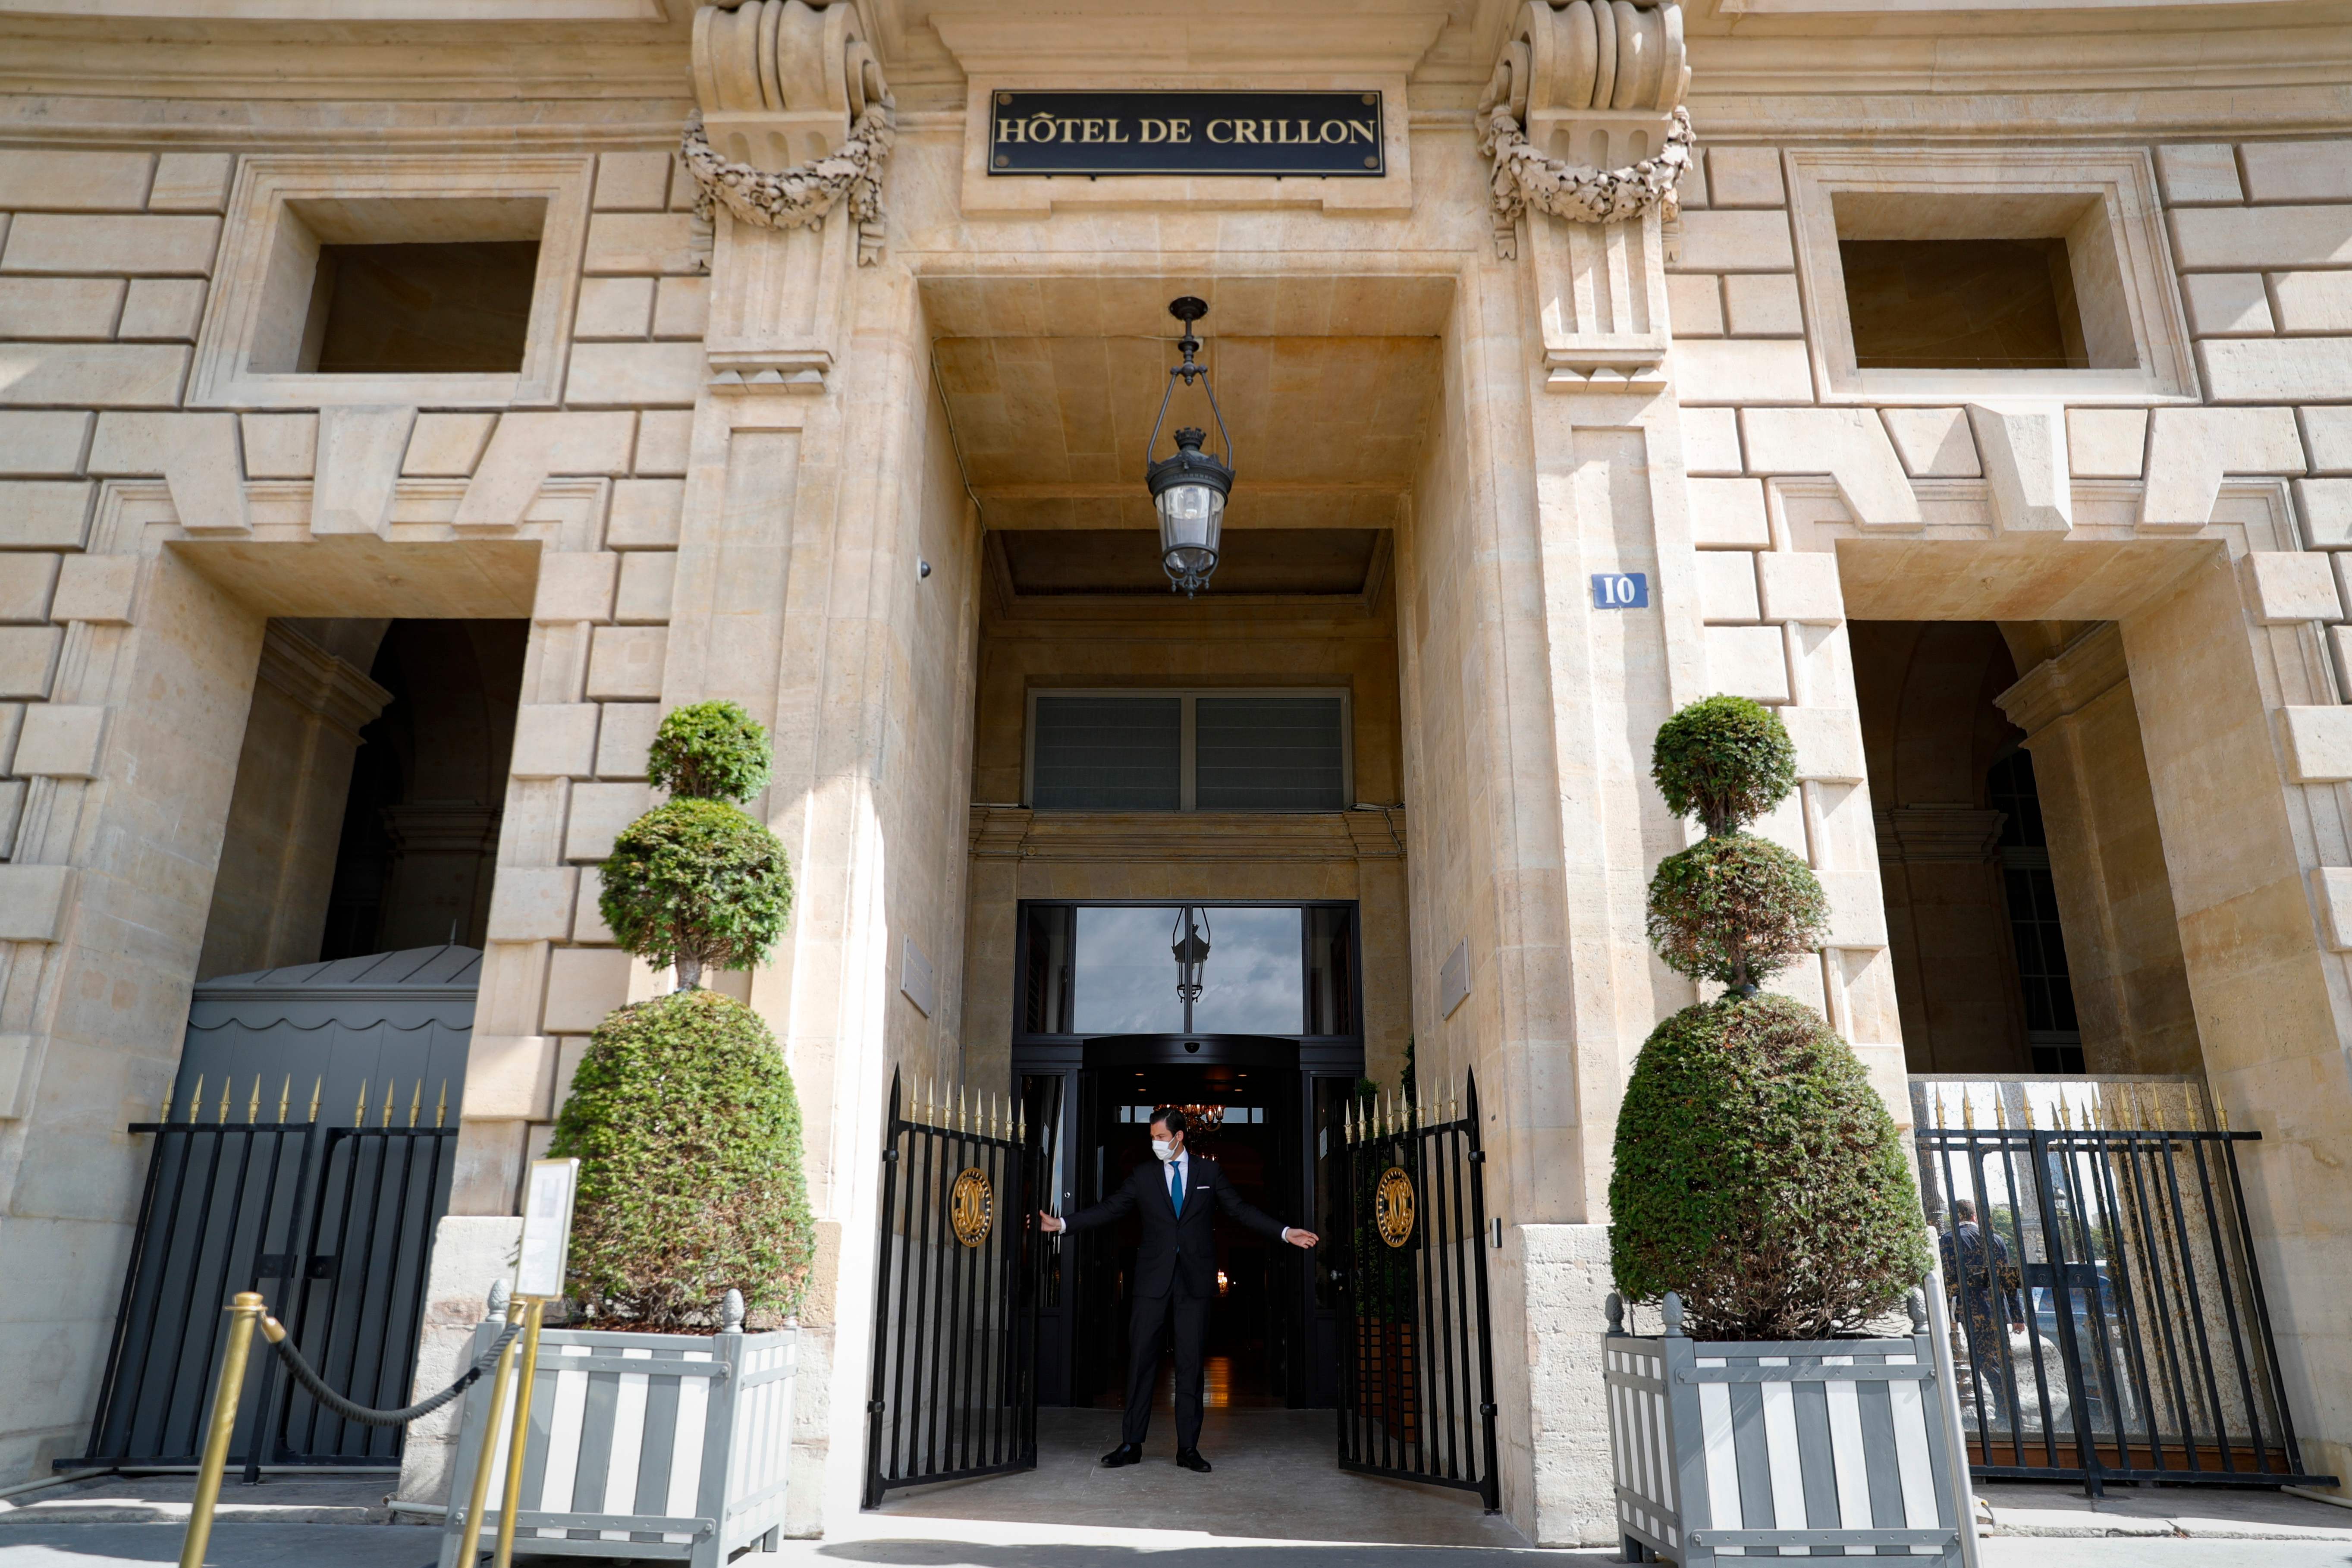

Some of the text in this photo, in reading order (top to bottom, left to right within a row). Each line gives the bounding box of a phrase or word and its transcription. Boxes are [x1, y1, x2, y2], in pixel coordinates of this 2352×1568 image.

[996, 111, 1375, 144] HÔTEL DE CRILLON
[1604, 577, 1635, 603] 10
